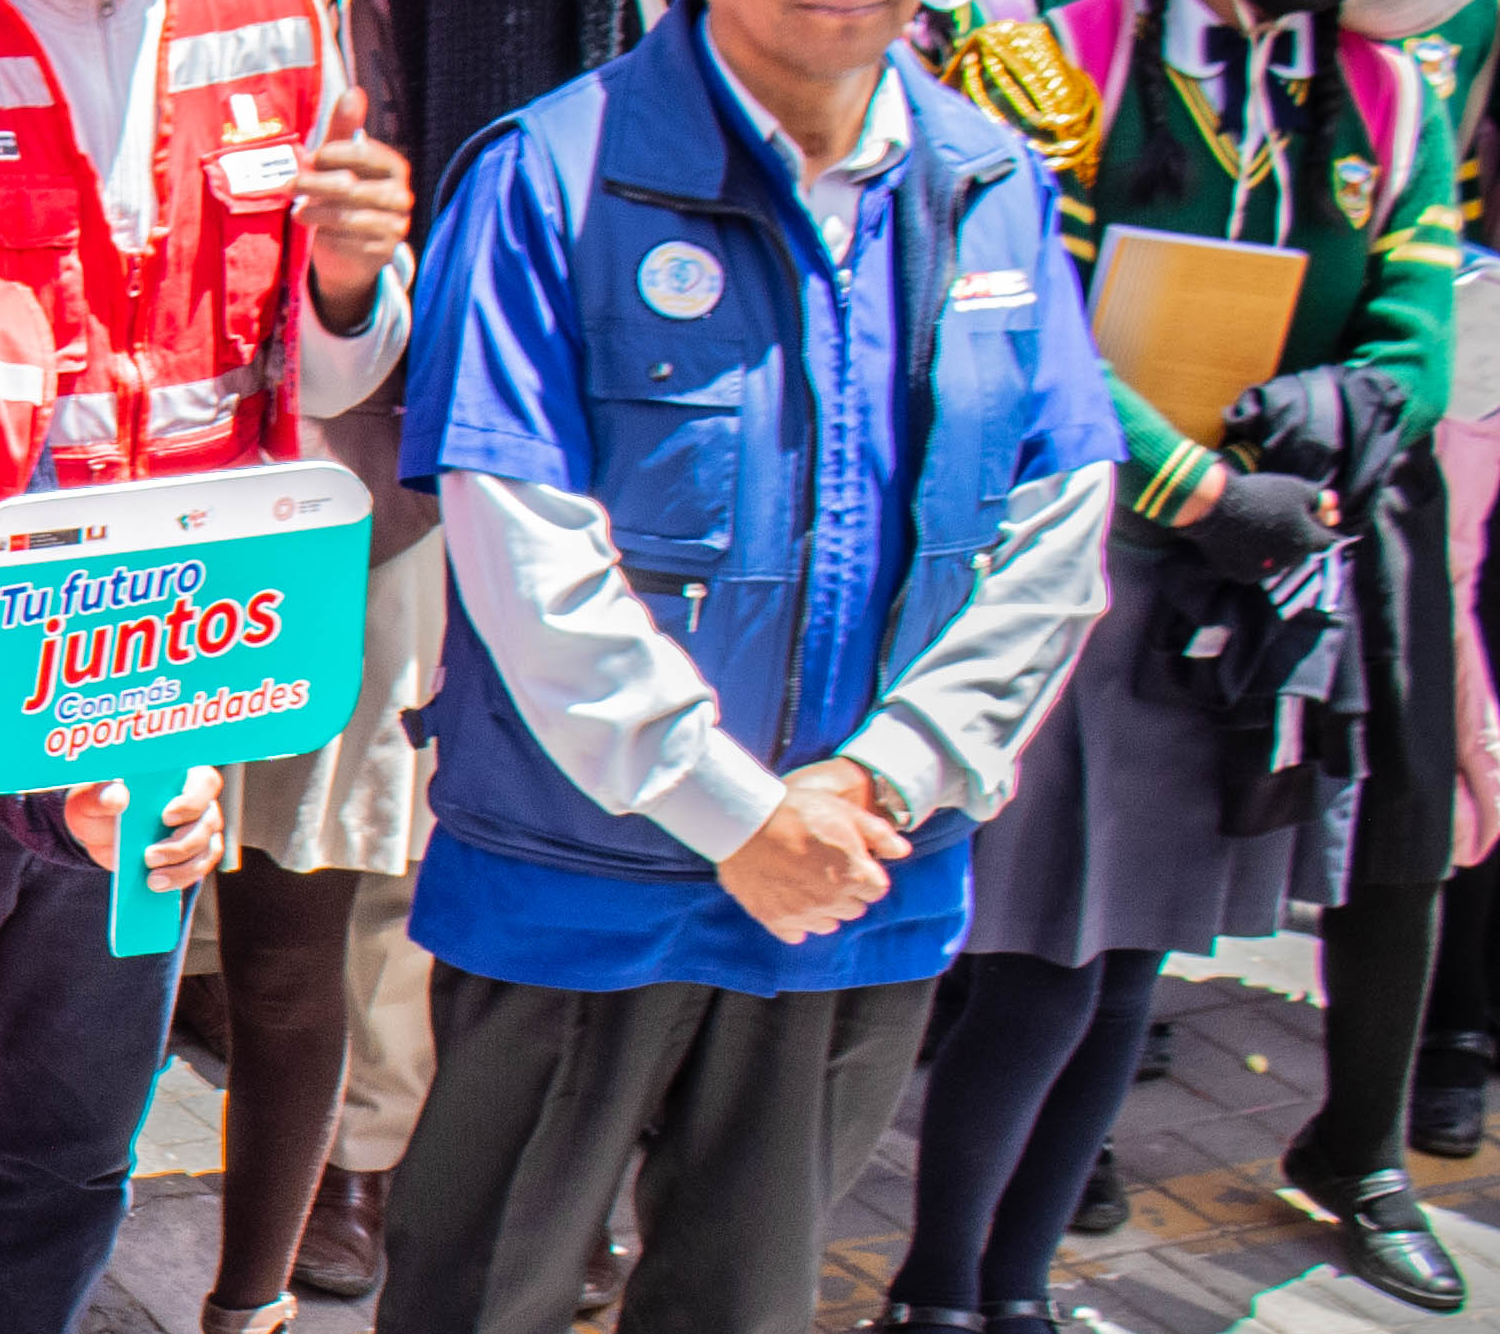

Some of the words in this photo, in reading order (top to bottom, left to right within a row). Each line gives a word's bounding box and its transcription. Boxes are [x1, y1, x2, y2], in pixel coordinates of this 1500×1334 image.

[0, 583, 52, 628] Tu
[60, 560, 205, 618] futuro
[23, 589, 284, 713] juntos
[45, 678, 310, 760] oportunidades
[56, 693, 114, 722] Con
[119, 677, 180, 712] más
